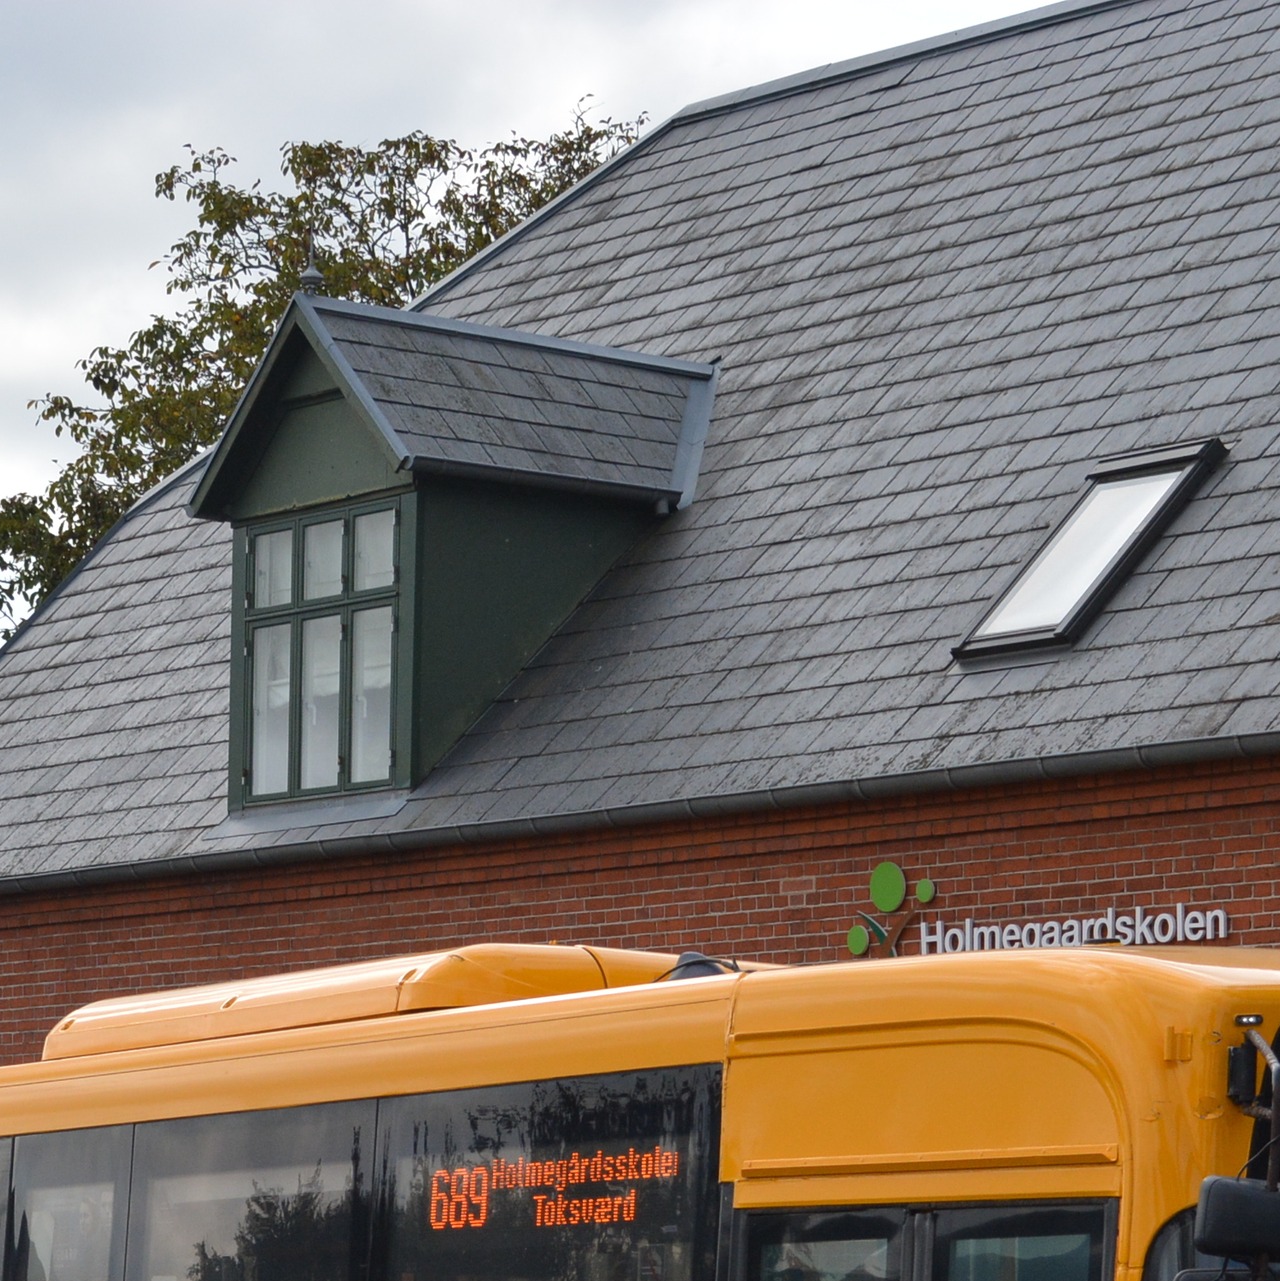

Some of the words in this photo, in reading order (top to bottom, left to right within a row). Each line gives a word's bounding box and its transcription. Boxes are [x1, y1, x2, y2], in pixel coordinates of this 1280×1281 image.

[920, 903, 1227, 955] Holmegaardskolen
[430, 1166, 489, 1230] 689
[532, 1188, 636, 1227] Toksværd
